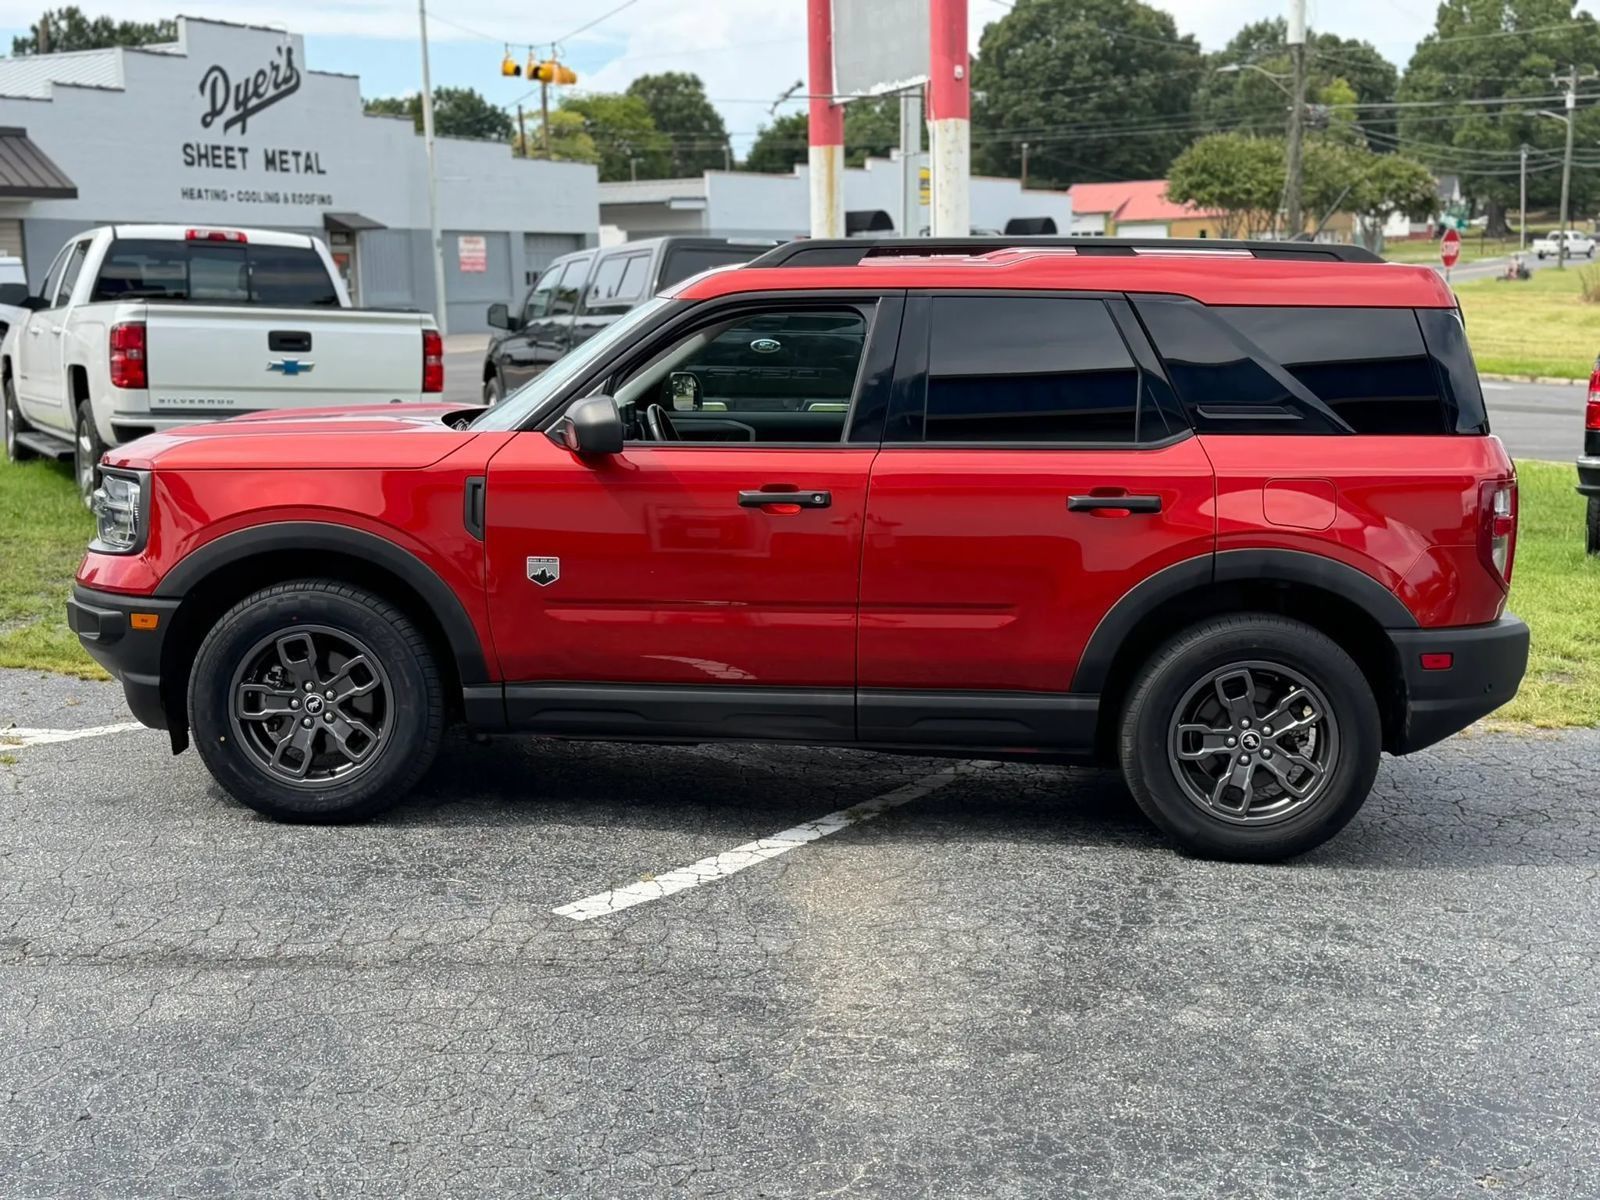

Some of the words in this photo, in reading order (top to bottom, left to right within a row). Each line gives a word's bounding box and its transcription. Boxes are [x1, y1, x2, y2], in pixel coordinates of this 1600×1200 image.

[199, 45, 301, 135] Dyer's
[182, 142, 249, 170] SHEET
[264, 148, 327, 175] METAL
[181, 187, 228, 202] HEATING
[236, 190, 281, 204] COOLING
[291, 193, 333, 206] ROOFING
